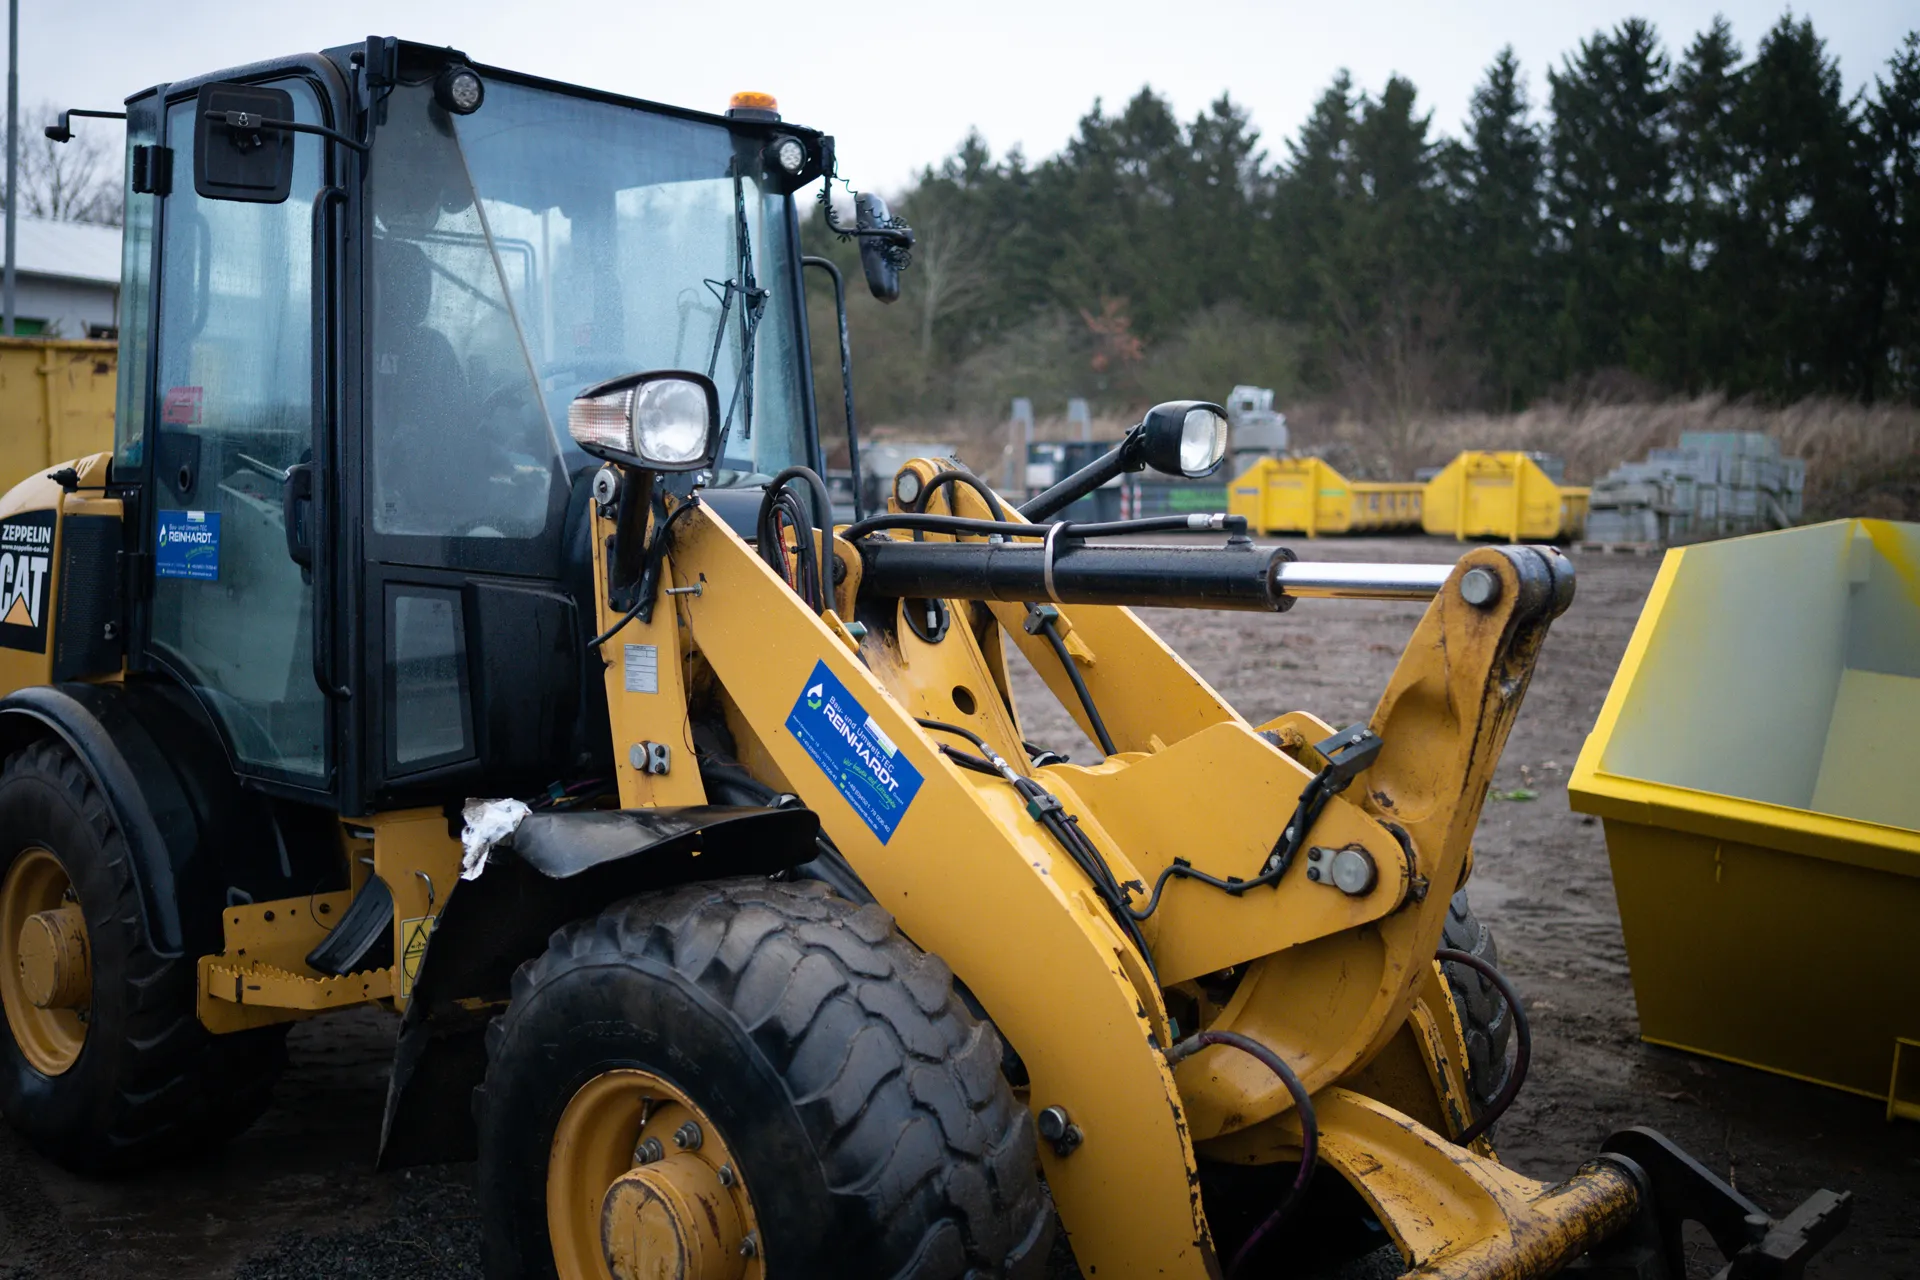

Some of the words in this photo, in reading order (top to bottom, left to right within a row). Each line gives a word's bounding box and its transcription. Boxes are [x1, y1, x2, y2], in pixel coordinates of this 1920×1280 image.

[1, 543, 50, 554] www.zeppelin-cat.de
[2, 524, 51, 544] ZEPPELIN
[169, 531, 212, 543] REINHARDT
[0, 552, 48, 628] CAT
[822, 702, 898, 795] REINHARDT
[829, 695, 844, 715] Bau-
[843, 712, 857, 729] und
[856, 726, 894, 773] Umwelt-TEC
